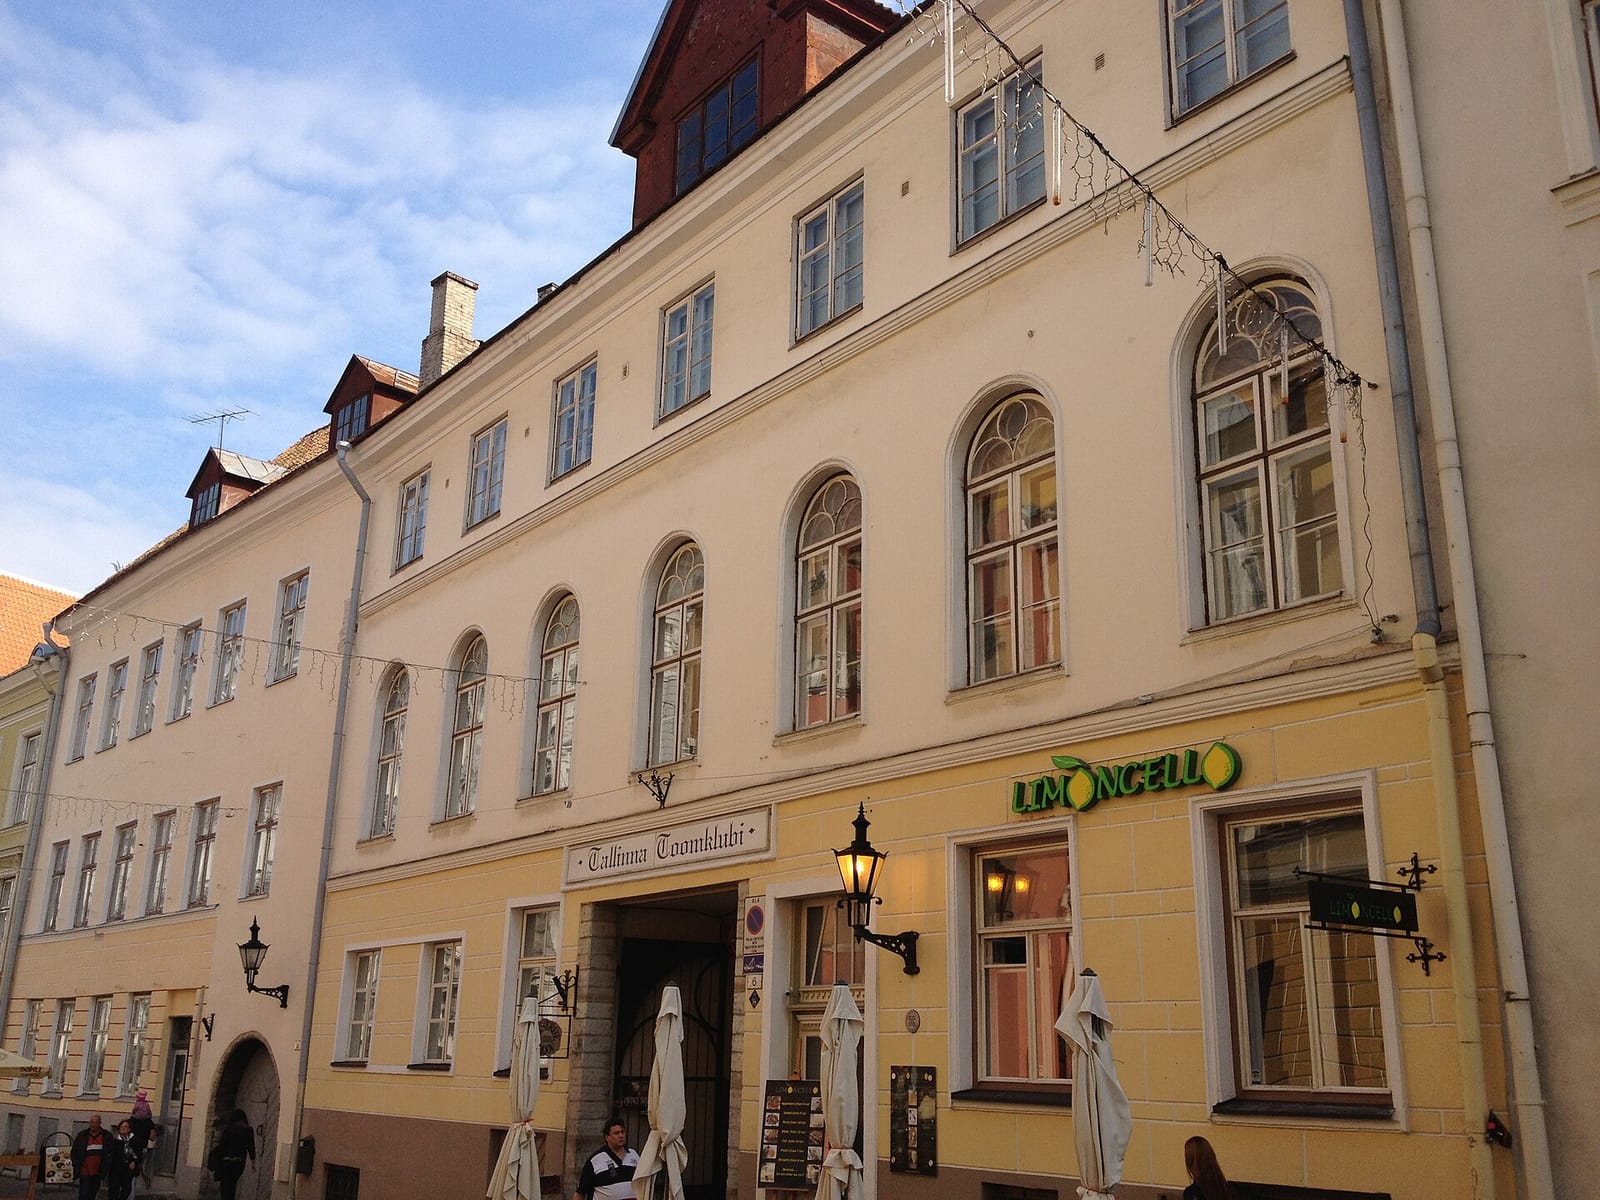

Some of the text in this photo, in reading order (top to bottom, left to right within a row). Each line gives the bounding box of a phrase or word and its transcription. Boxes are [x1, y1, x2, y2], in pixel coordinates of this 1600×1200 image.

[1012, 742, 1242, 813] LIMONCELLO
[588, 821, 744, 872] Tallinna Toomklubi
[1329, 898, 1402, 924] LIMONCELLO
